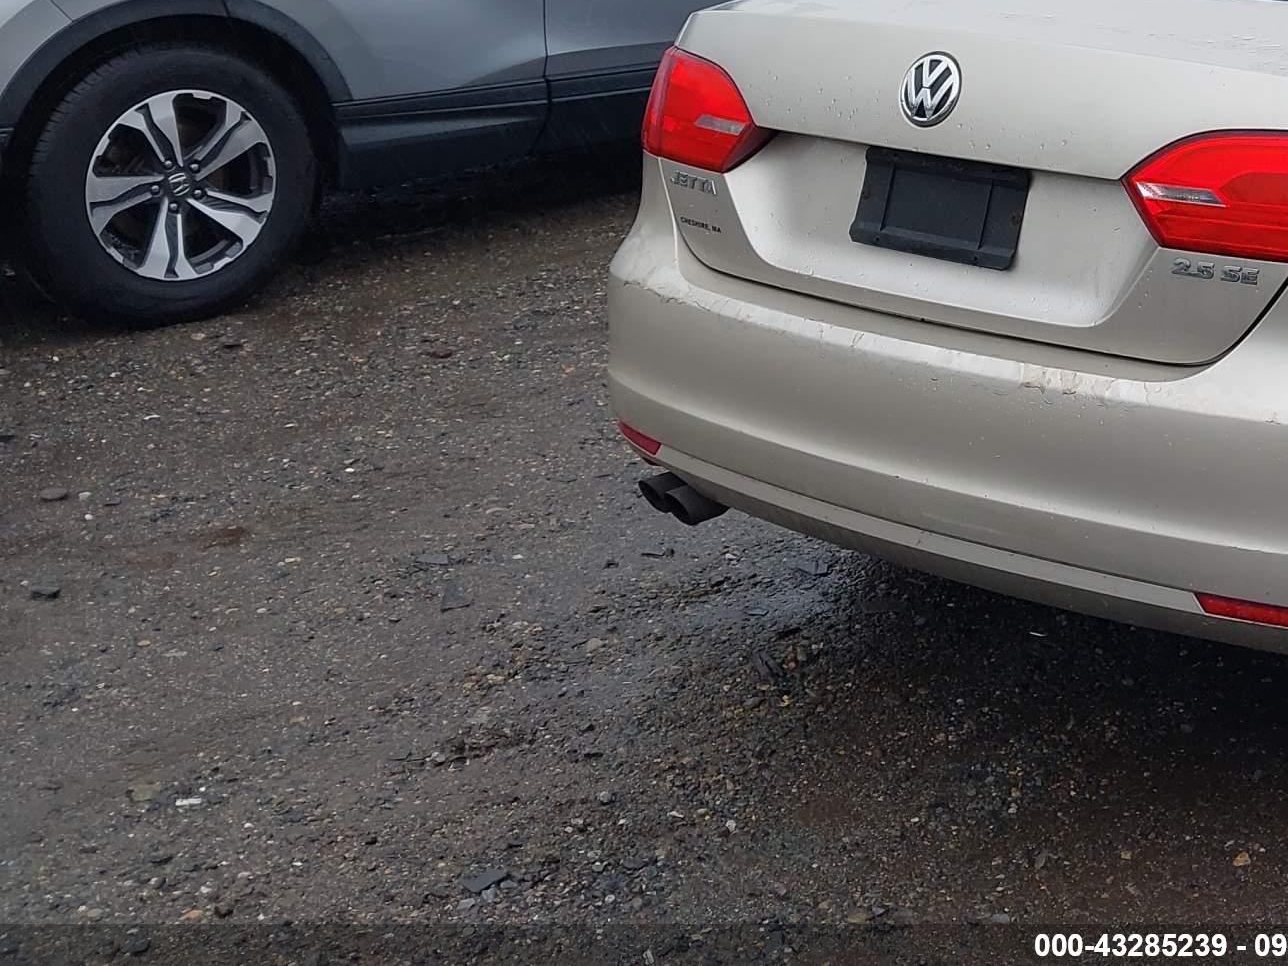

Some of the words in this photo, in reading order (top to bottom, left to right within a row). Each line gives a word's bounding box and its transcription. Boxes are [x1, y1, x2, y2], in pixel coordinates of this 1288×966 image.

[670, 170, 717, 195] JETTA
[1171, 257, 1215, 280] 2.5
[1220, 265, 1260, 286] SE
